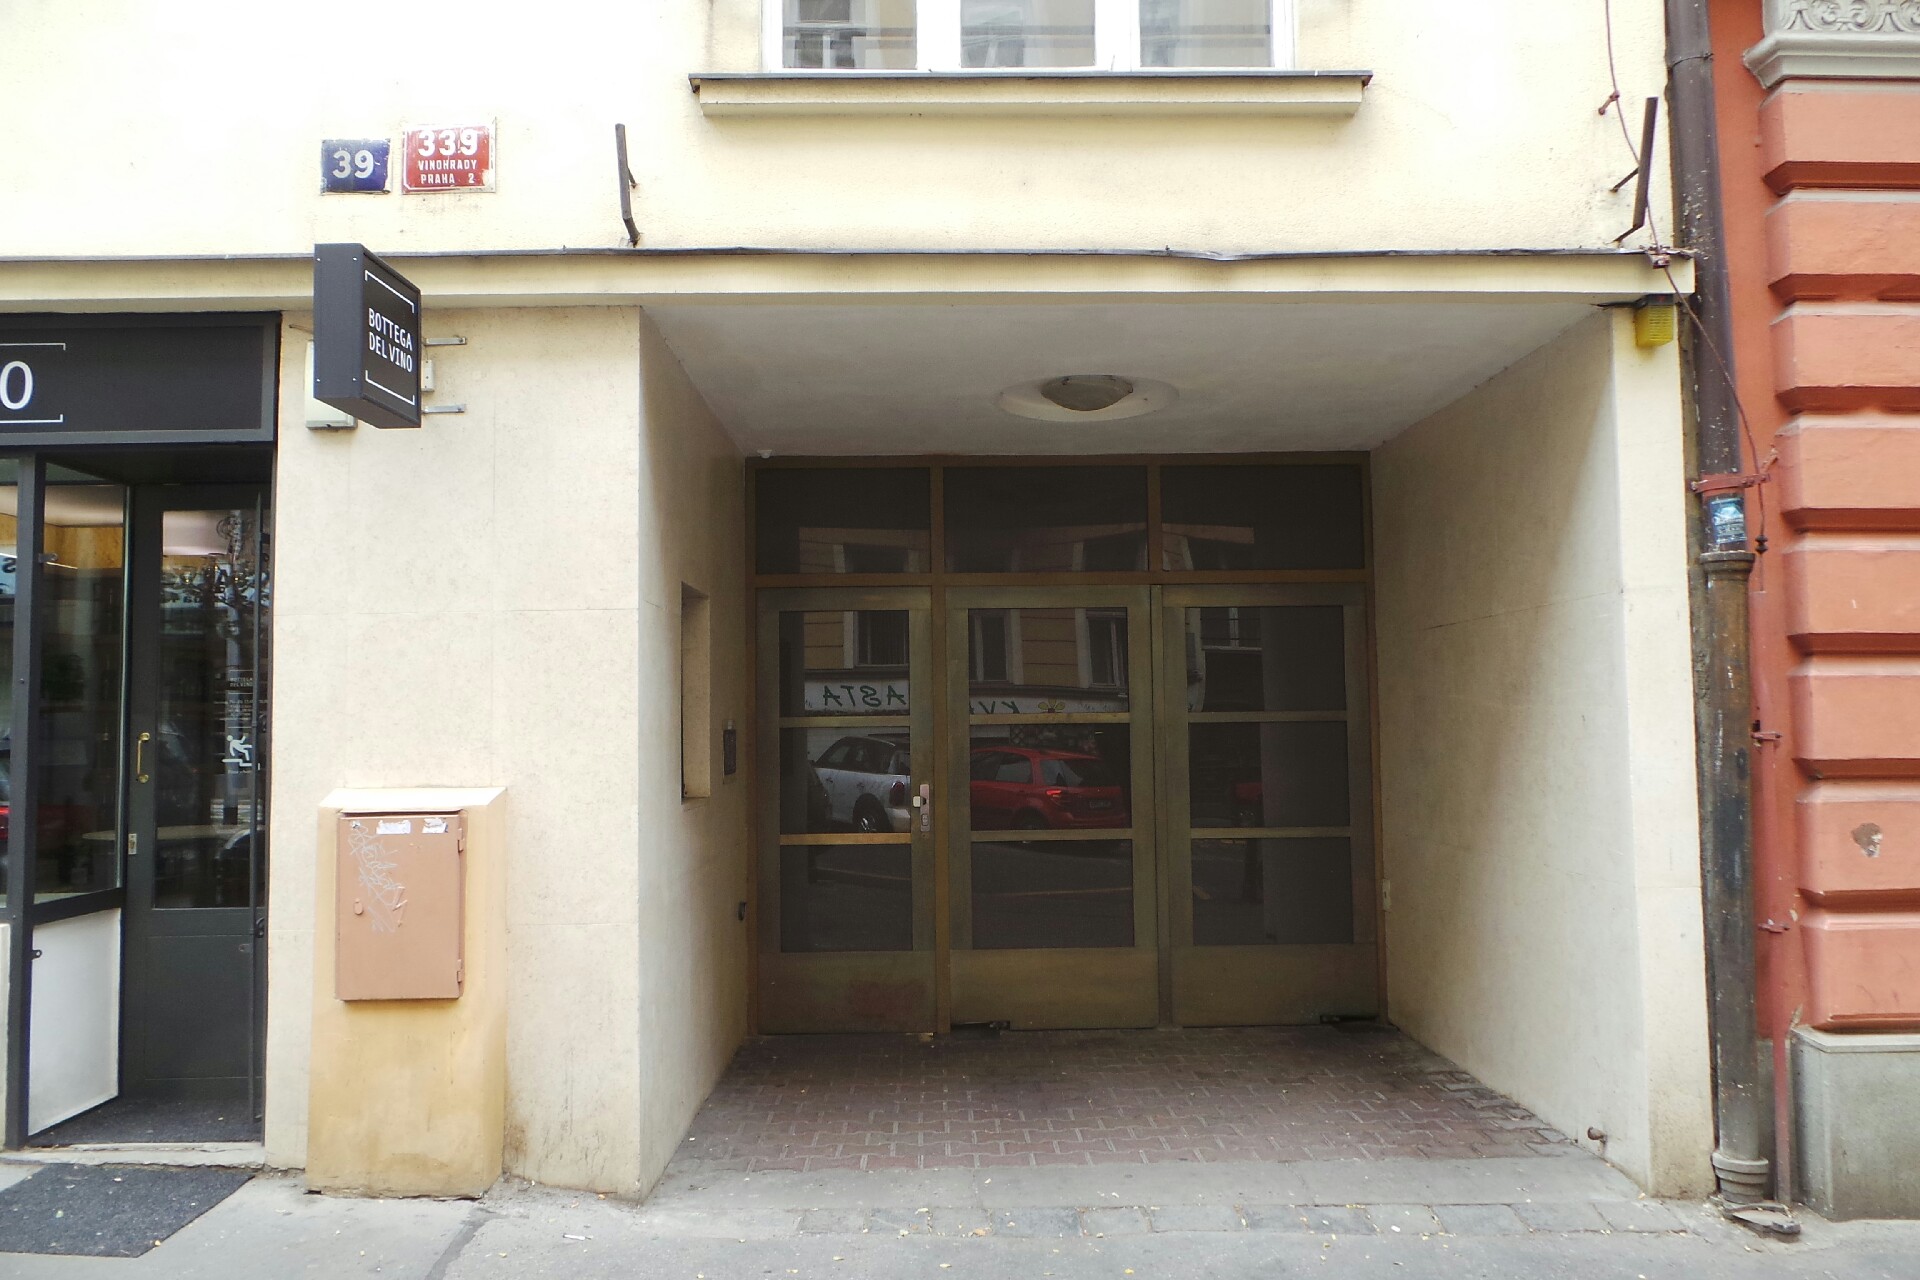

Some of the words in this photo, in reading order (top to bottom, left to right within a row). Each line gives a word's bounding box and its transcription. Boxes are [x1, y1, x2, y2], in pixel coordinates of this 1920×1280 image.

[417, 128, 478, 157] 339
[332, 150, 374, 179] 39
[418, 159, 478, 171] VINOHRADY
[420, 172, 455, 184] PRAHA
[468, 172, 475, 184] 2
[368, 307, 413, 351] BOTTEGA
[368, 331, 388, 358] DEL
[388, 344, 413, 373] VINO
